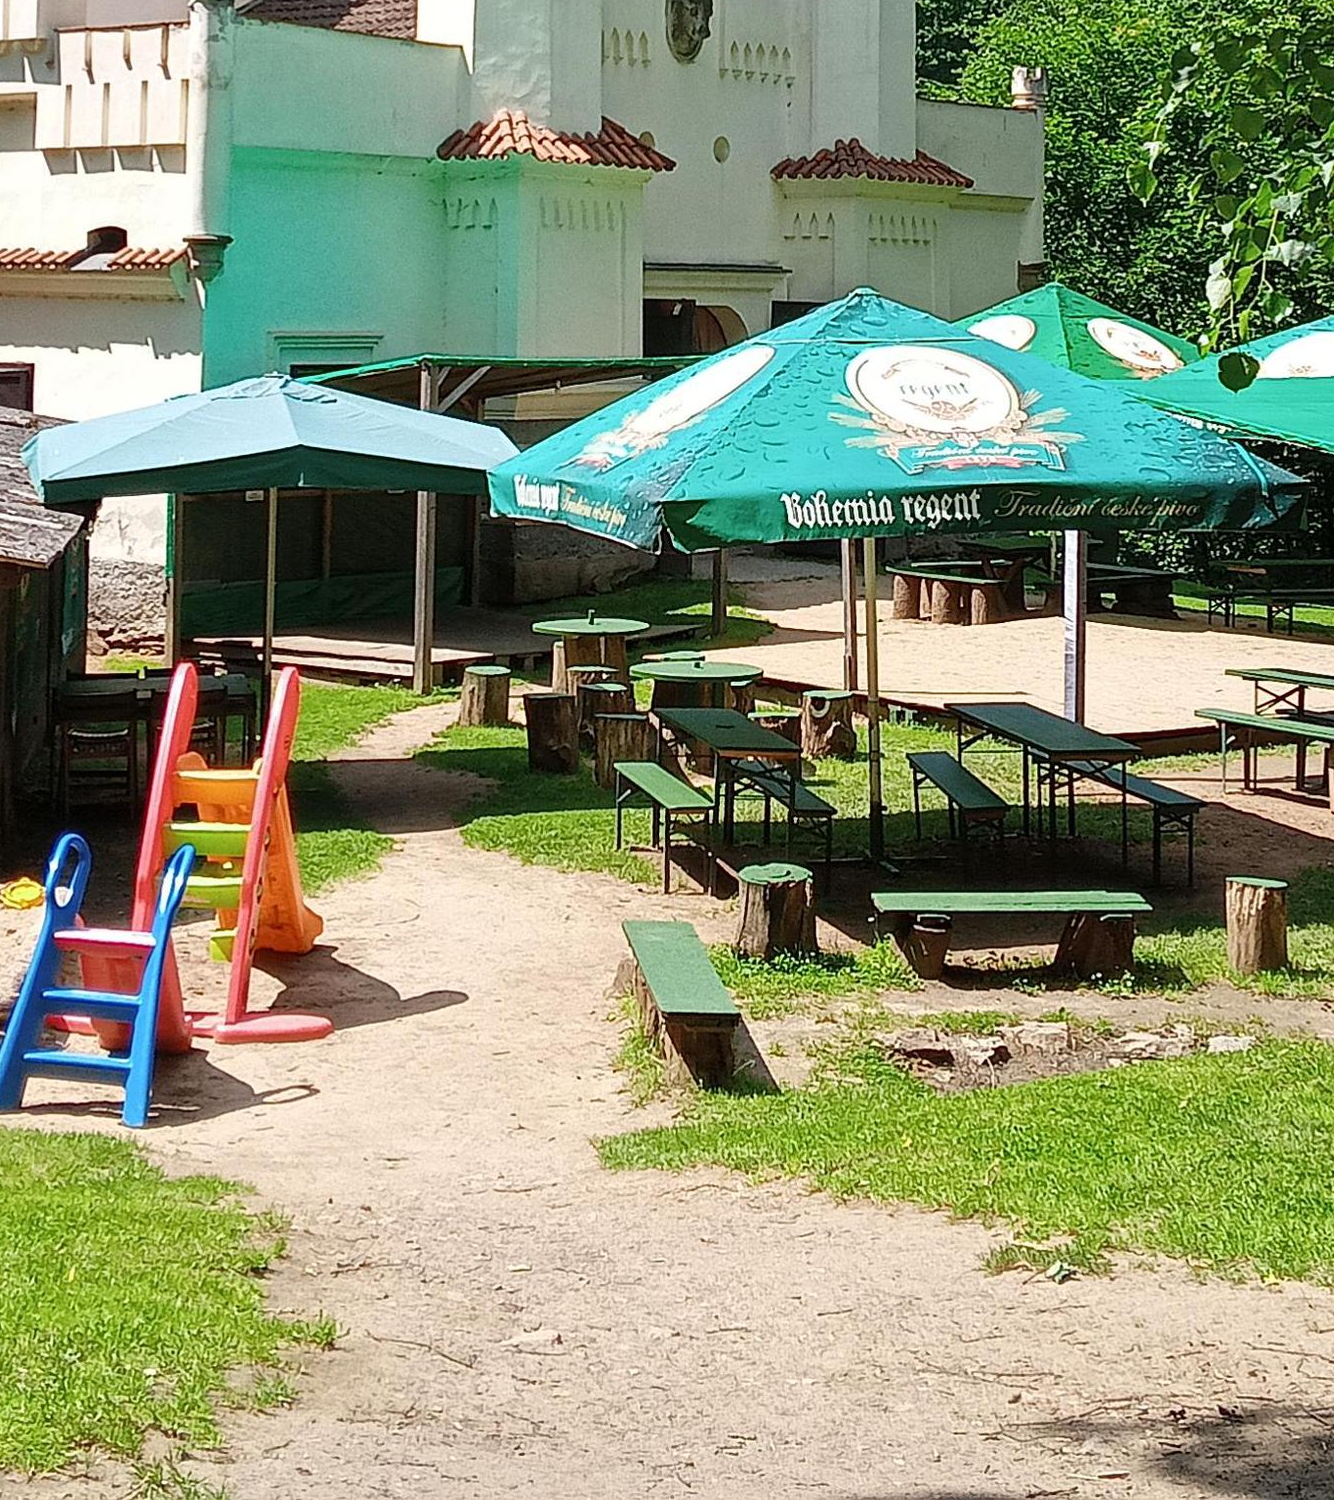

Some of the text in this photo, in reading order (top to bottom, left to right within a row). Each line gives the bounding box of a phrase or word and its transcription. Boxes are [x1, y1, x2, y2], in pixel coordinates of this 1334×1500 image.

[780, 488, 982, 529] Bohemia regent
[994, 490, 1101, 517] Tradiční
[1149, 497, 1200, 526] pivo
